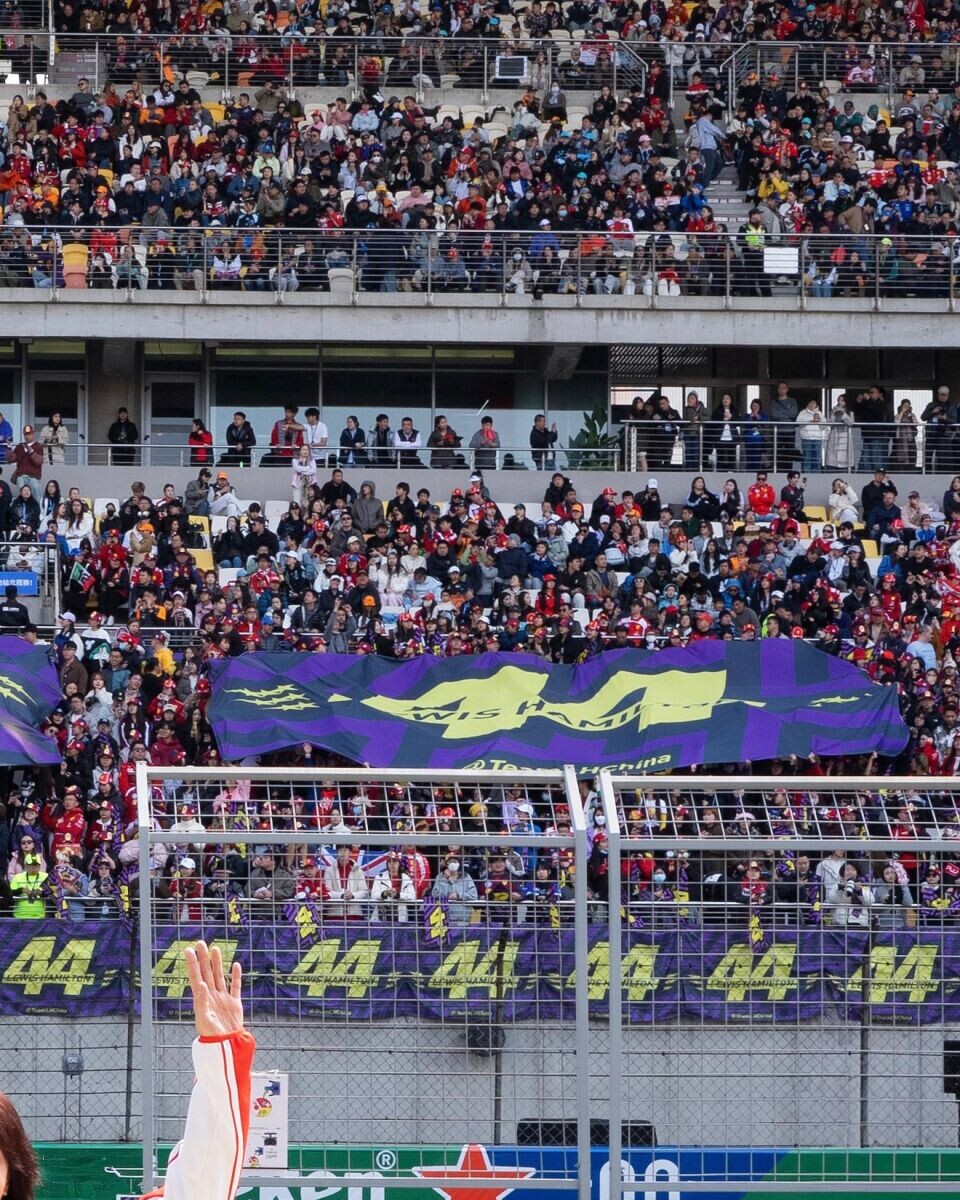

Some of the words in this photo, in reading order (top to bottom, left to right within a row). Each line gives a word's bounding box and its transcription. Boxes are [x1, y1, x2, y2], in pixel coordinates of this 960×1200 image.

[2, 936, 96, 995] 44
[7, 974, 38, 983] LEWIS
[40, 974, 91, 983] HAMILTON
[286, 938, 381, 998] 44
[428, 940, 520, 998] 44
[565, 942, 660, 1000] 44
[706, 943, 797, 1001] 44
[846, 945, 938, 1003] 44
